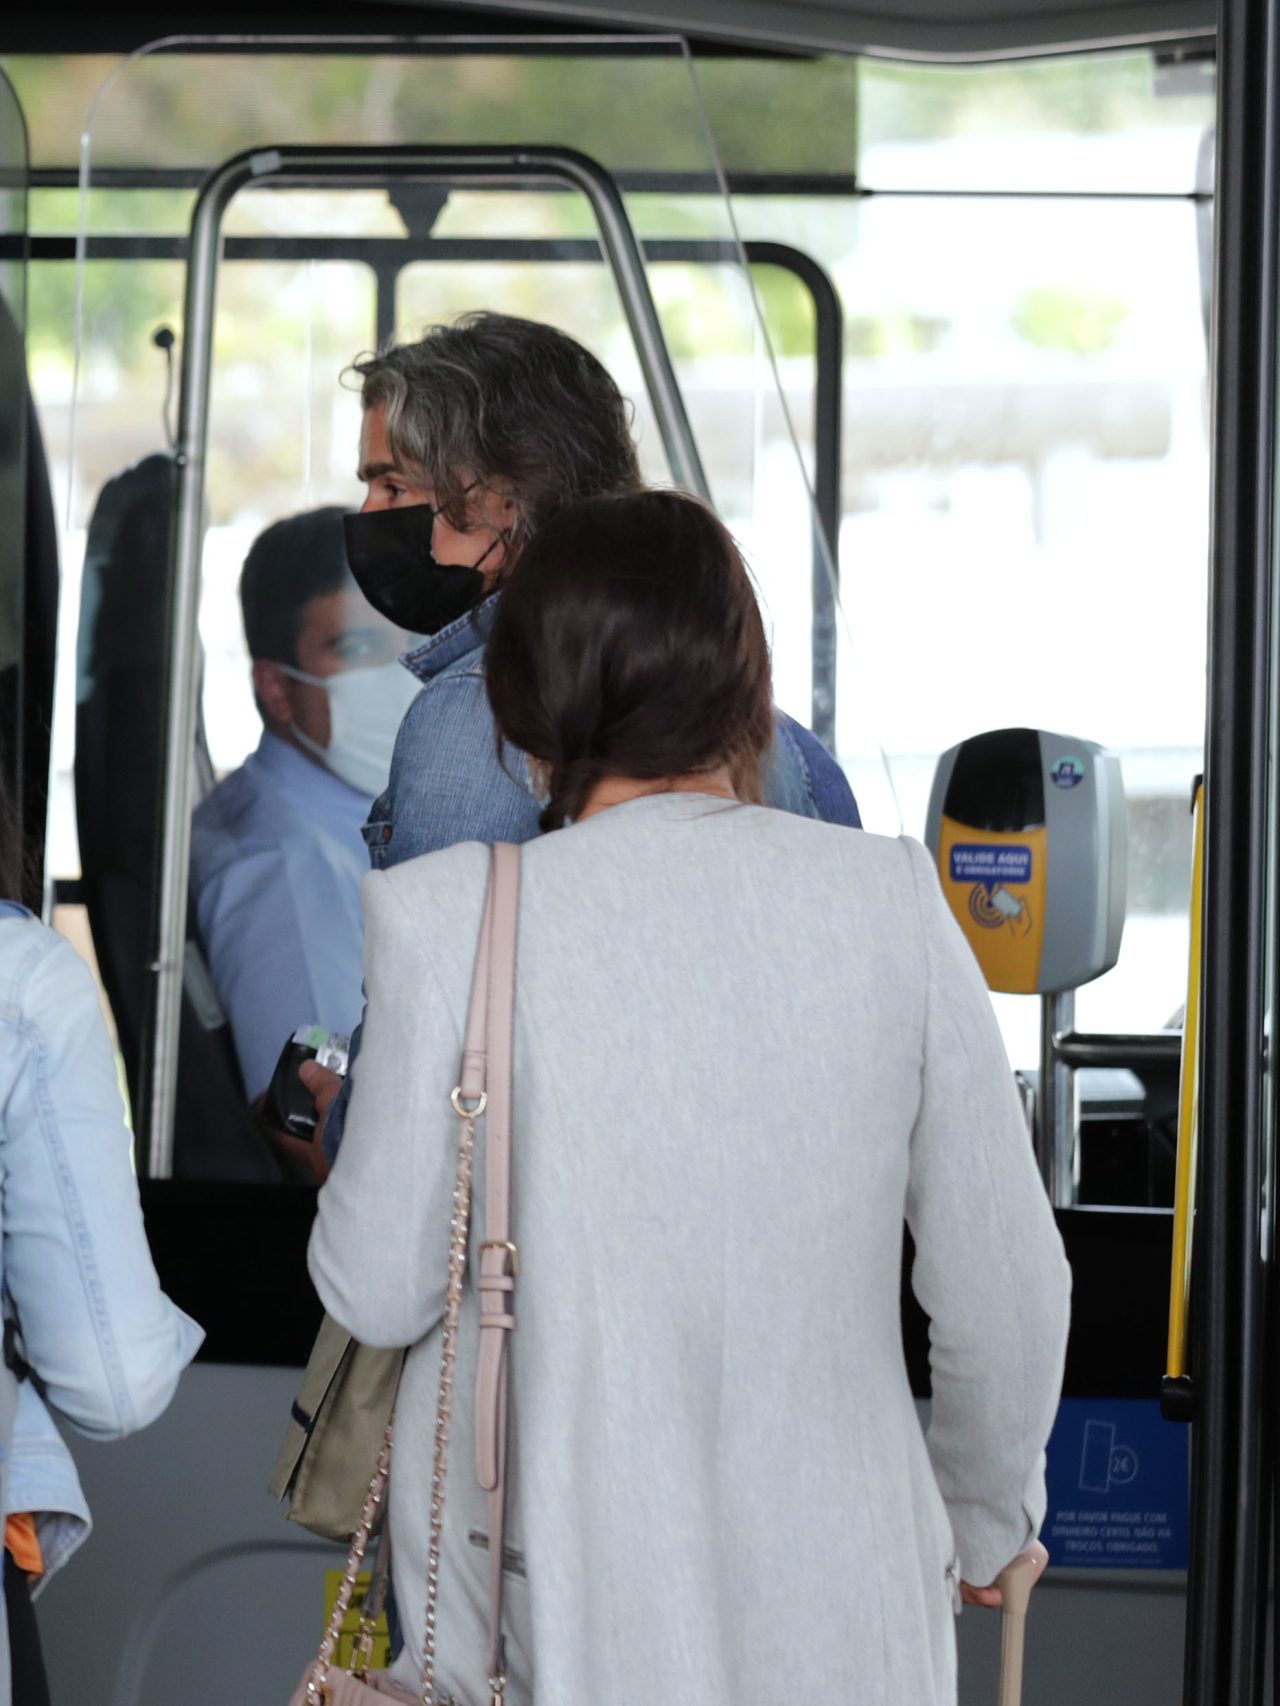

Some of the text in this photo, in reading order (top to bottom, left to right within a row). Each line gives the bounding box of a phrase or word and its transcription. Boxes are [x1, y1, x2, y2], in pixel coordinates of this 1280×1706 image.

[953, 851, 1029, 865] VALIDE AQUI
[1113, 1456, 1128, 1473] 2€
[1056, 1511, 1168, 1523] POR FAVOR PAGUE COM
[1052, 1525, 1098, 1537] DINHEIRO
[1134, 1525, 1155, 1538] NÃO
